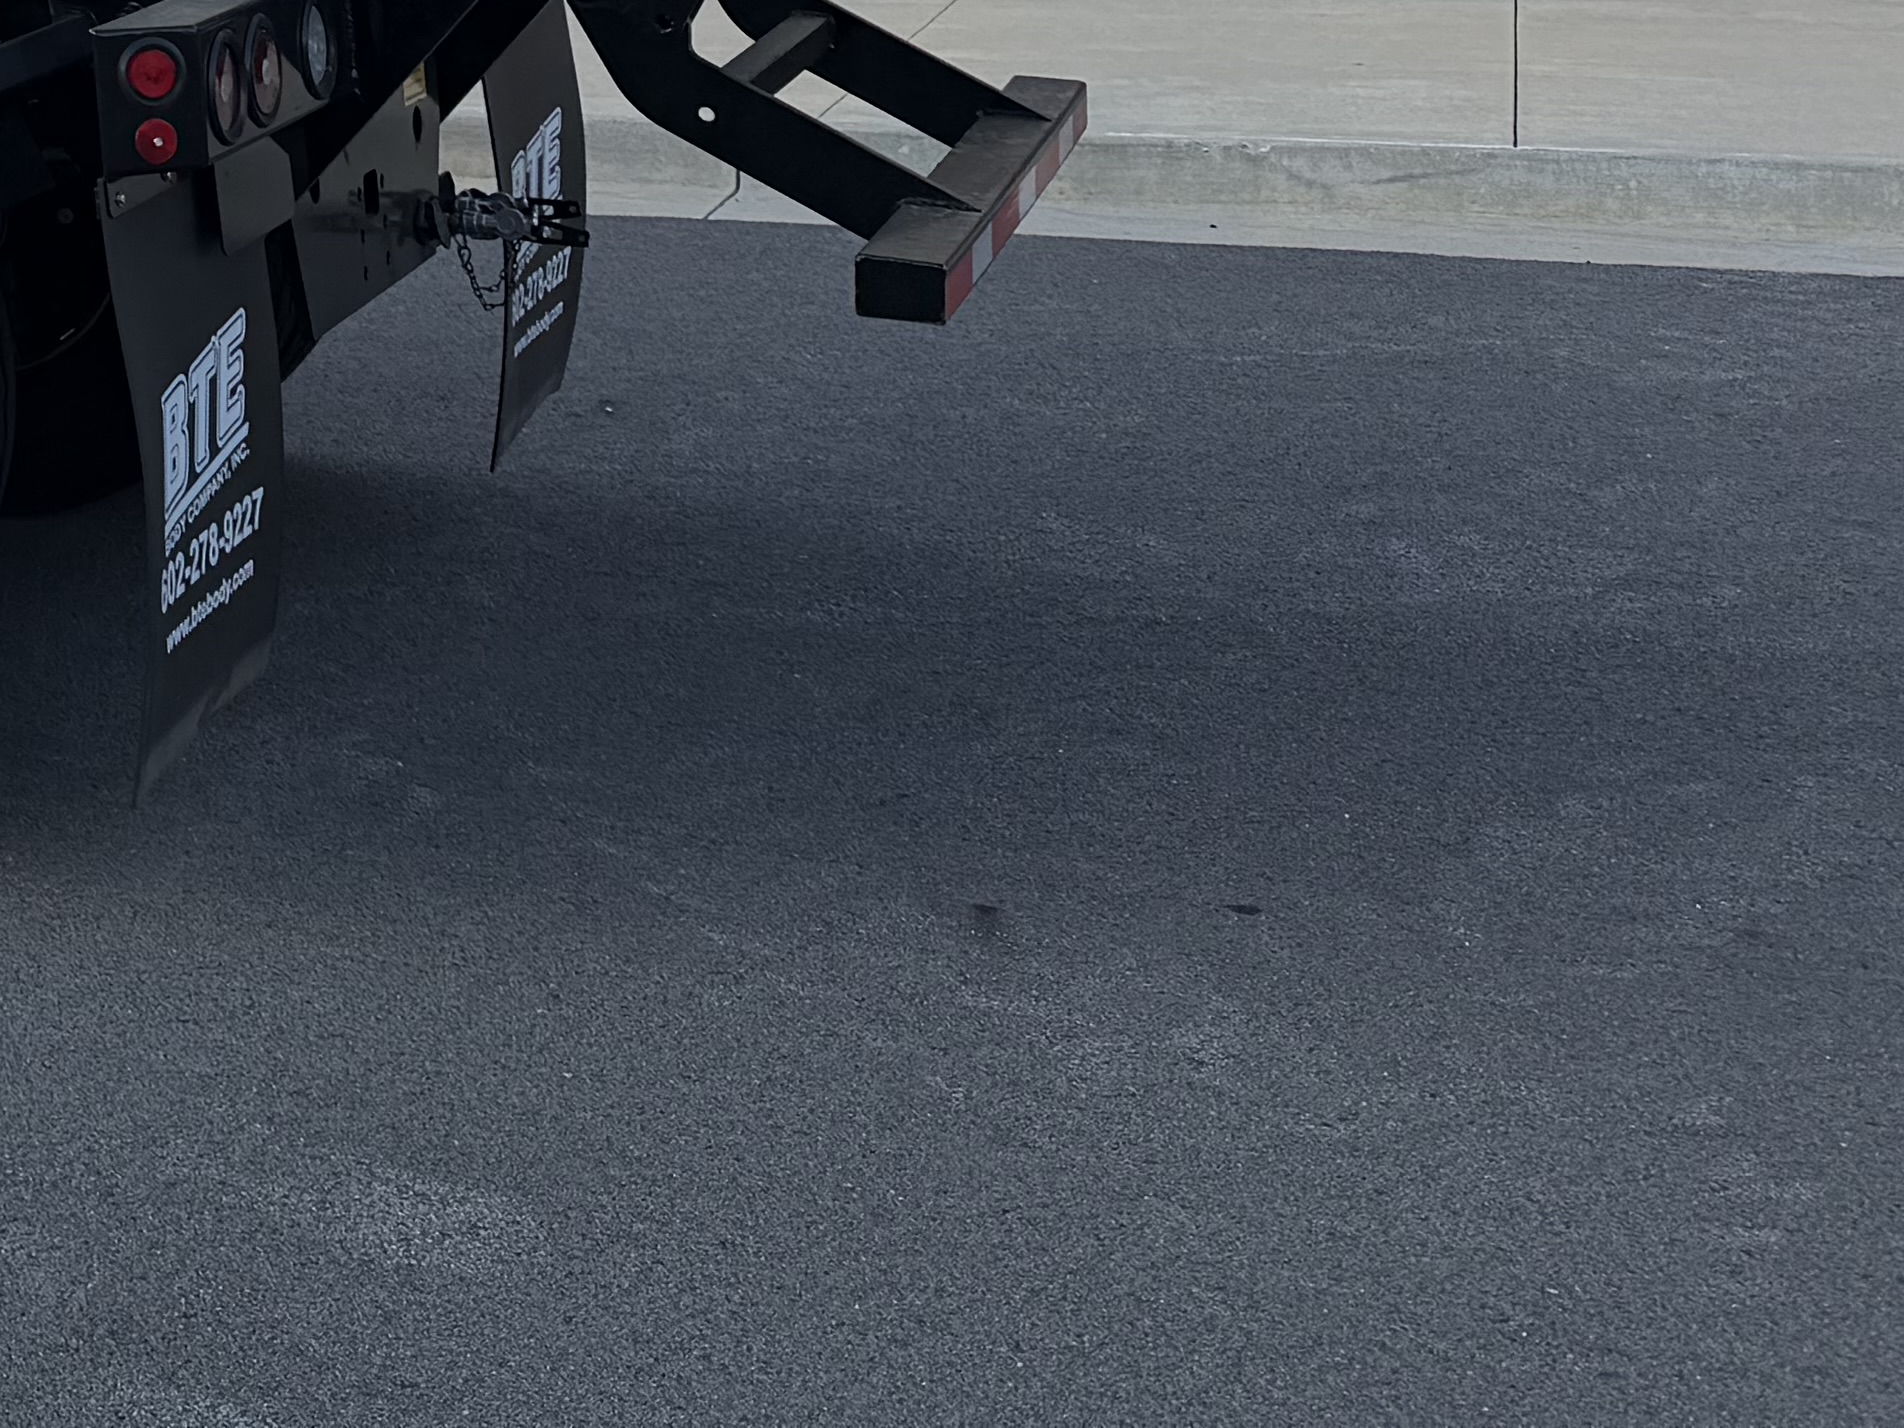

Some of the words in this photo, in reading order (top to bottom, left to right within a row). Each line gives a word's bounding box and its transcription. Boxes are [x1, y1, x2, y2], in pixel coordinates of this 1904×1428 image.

[161, 306, 246, 522] BTE
[231, 442, 251, 473] INC.
[161, 486, 264, 614] 602-278-9227
